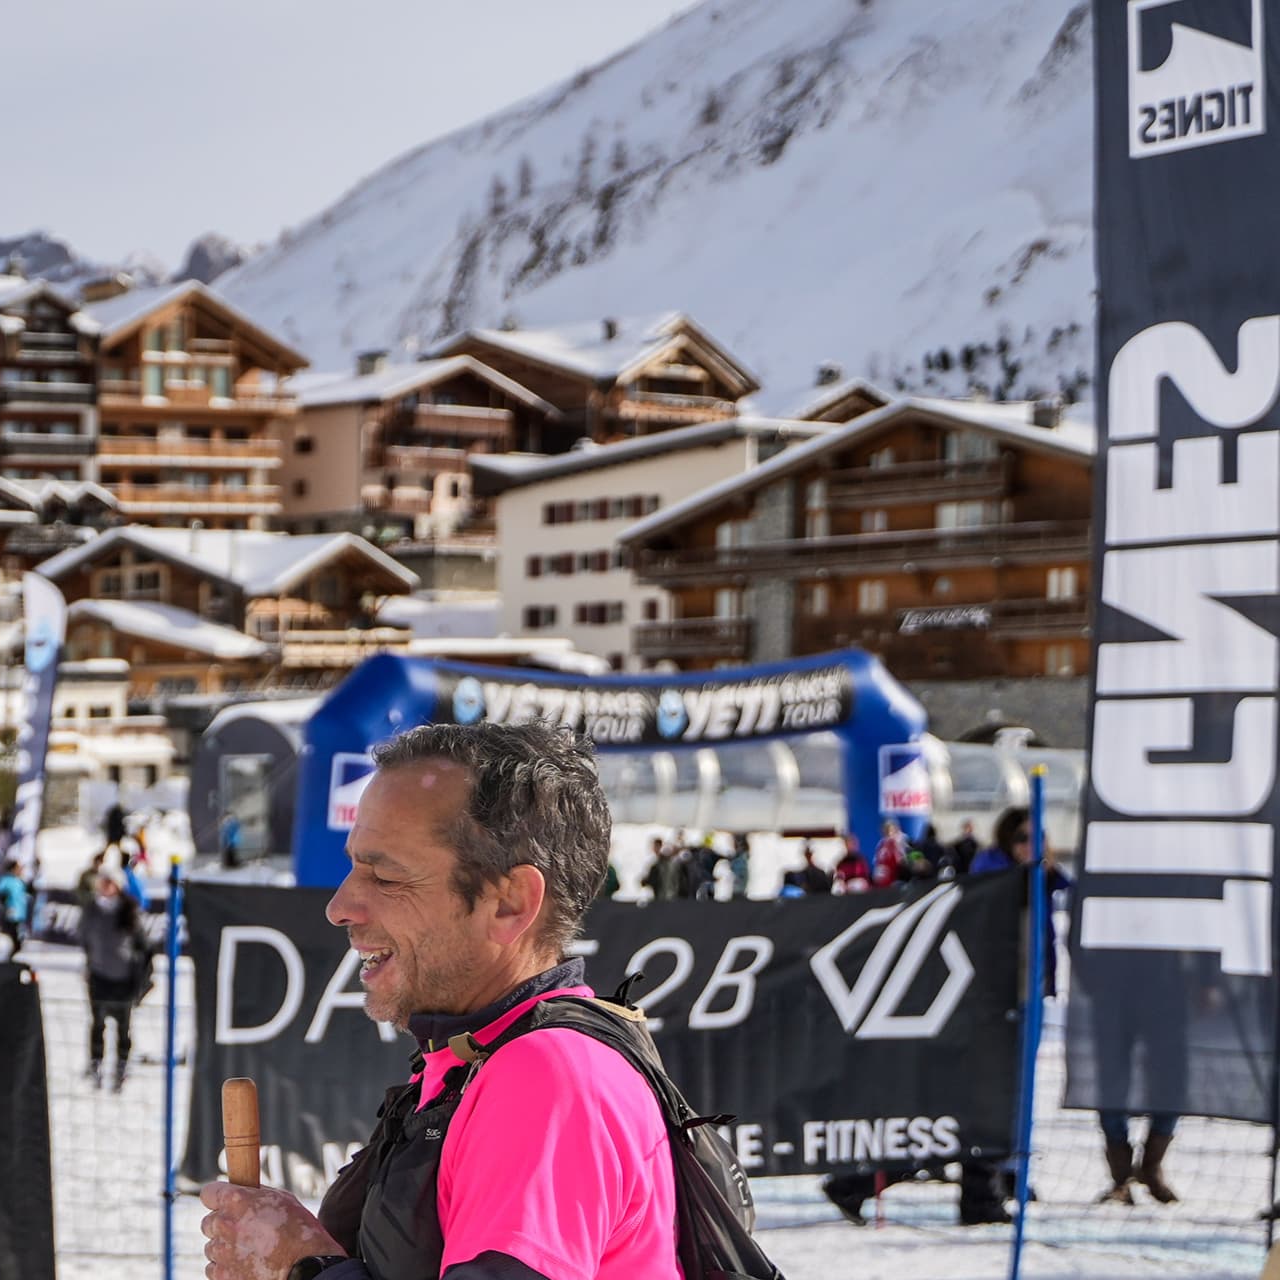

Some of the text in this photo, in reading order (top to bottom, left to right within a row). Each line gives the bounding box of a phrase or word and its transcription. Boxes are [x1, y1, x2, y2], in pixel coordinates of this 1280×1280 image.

[482, 682, 584, 731] YETI
[585, 715, 646, 744] TOUR
[681, 684, 783, 743] YETI
[781, 699, 842, 728] TOUR
[802, 1114, 961, 1166] FITNESS
